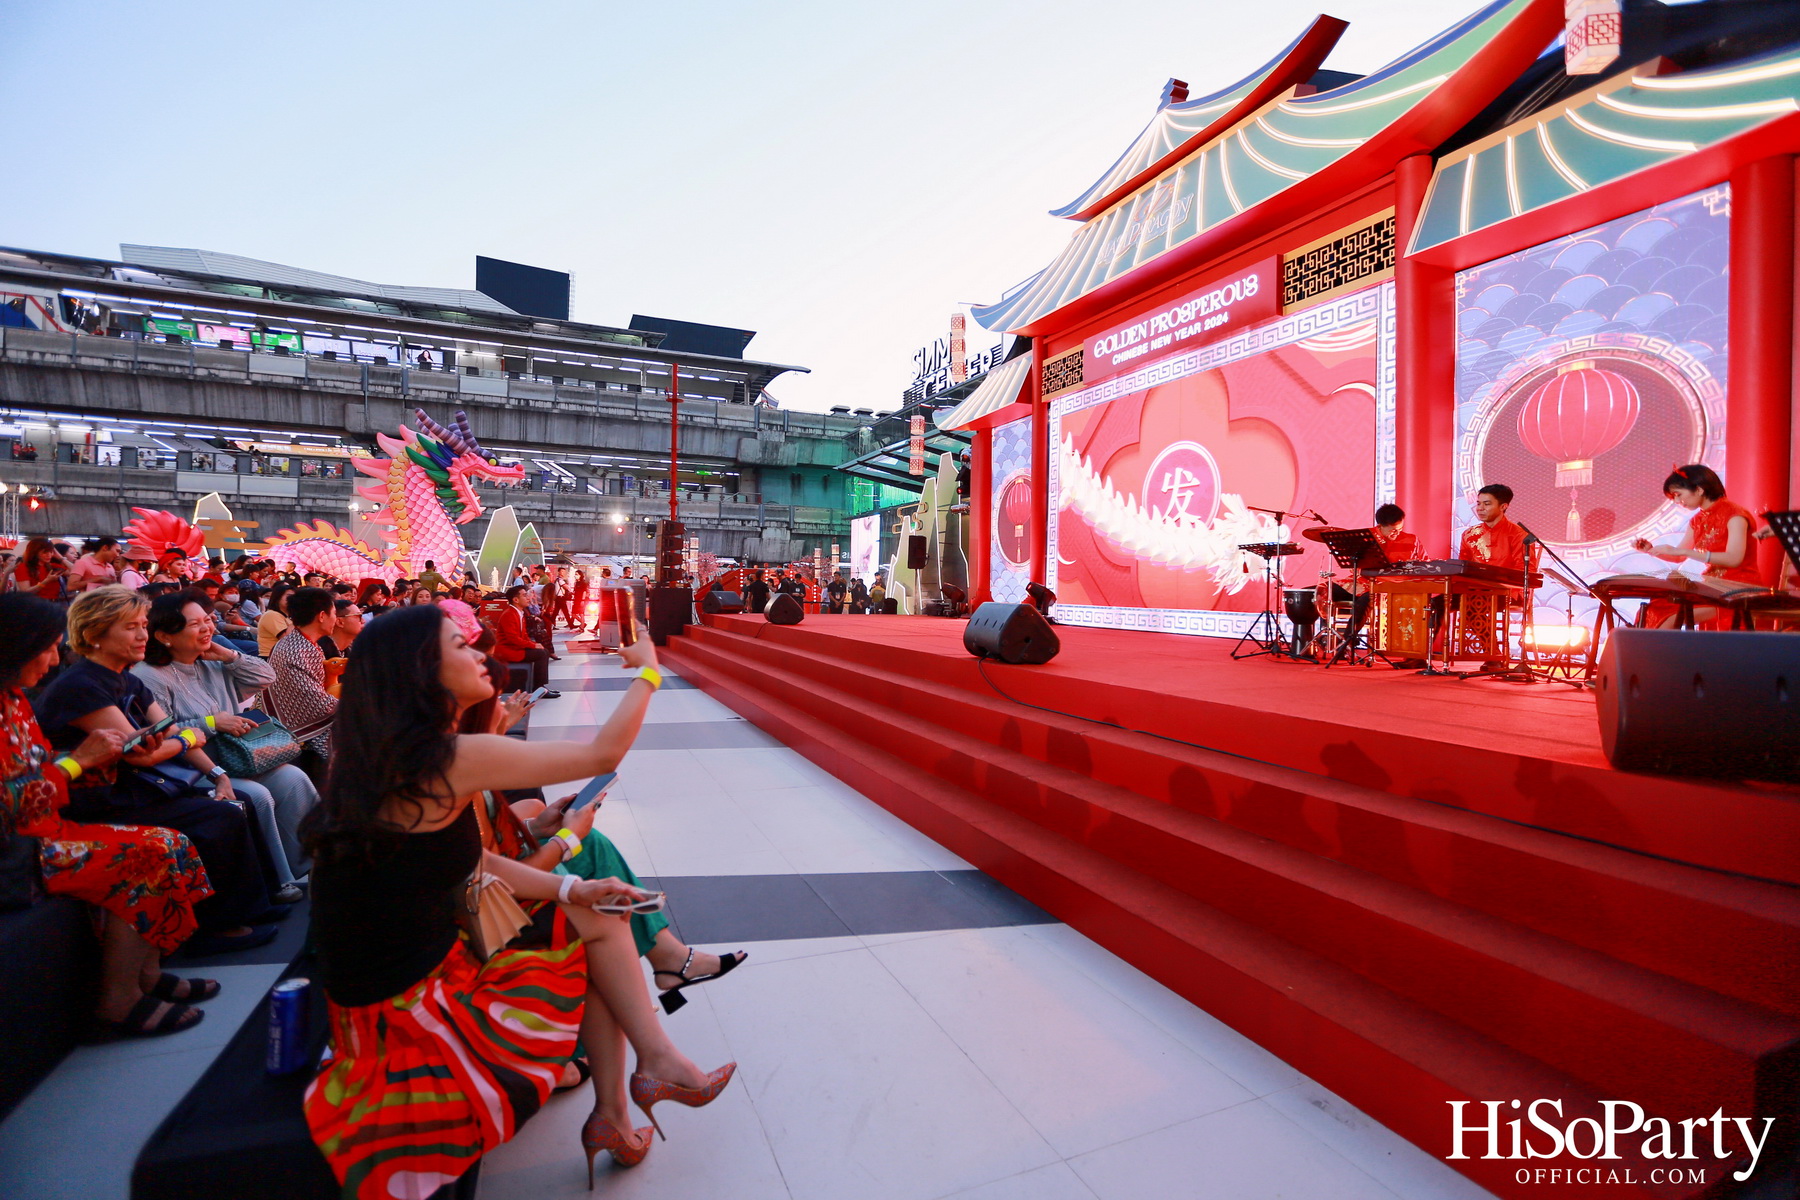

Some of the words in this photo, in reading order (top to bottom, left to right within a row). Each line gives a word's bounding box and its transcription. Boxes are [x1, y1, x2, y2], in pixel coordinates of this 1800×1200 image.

[1094, 320, 1149, 358] GOLDEN
[1149, 274, 1259, 337] PROSPEROUS
[1112, 343, 1149, 365] CHINESE
[1150, 335, 1173, 351] NEW
[1174, 324, 1202, 342] YEAR
[1203, 311, 1229, 331] 2024
[1161, 467, 1201, 522] 发
